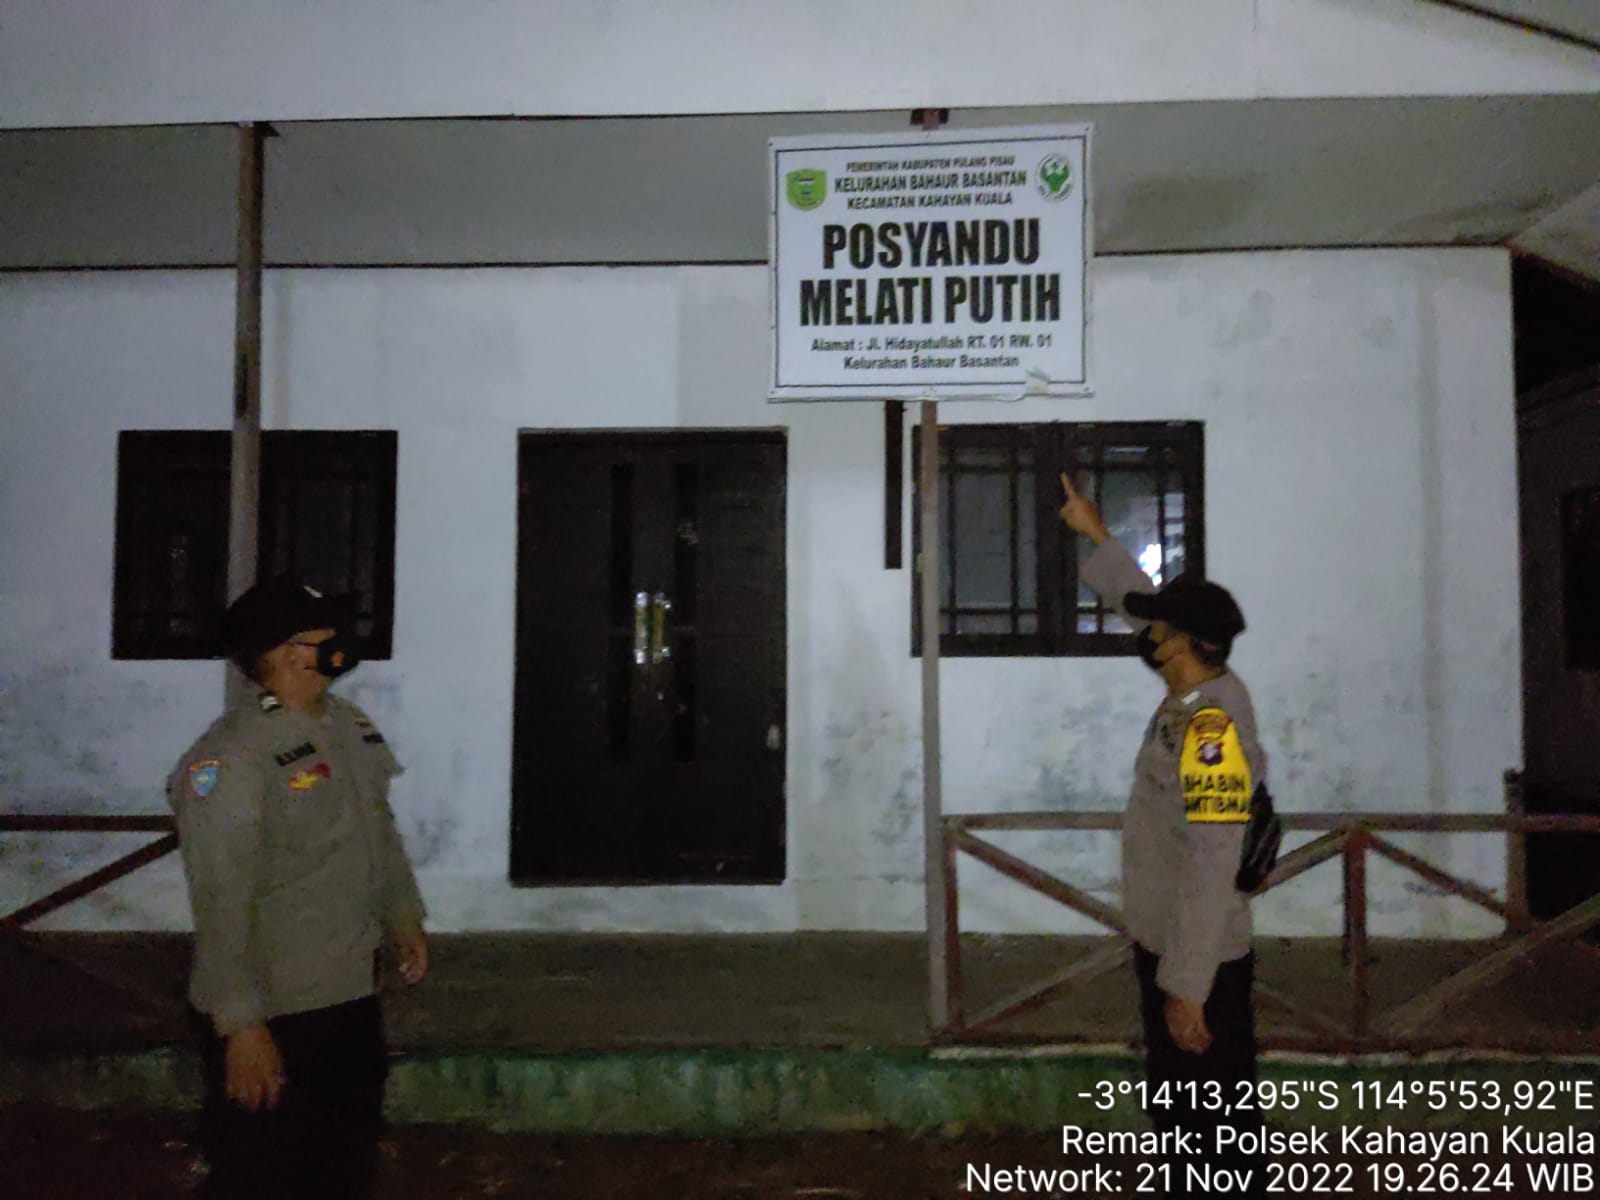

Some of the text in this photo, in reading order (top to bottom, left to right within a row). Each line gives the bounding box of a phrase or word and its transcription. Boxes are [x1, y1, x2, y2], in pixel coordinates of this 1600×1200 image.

[901, 158, 950, 171] KABUPATEN
[953, 156, 987, 168] PULANG
[989, 155, 1015, 166] PISAU
[834, 170, 1027, 193] KELURAHAN BAHAUR BASANTAN
[847, 192, 1012, 210] KECAMATAN KAHAYAN KUALA
[823, 218, 1040, 269] POSYANDU
[800, 273, 1061, 326] MELATI PUTIH
[811, 338, 855, 351] Alamat
[885, 335, 963, 352] Hidayatullah
[967, 335, 986, 348] RT.
[990, 335, 1005, 348] 01
[1009, 335, 1033, 348] RW.
[1037, 334, 1052, 347] 01
[844, 355, 1019, 370] Kelurahan Bahaur Basantan
